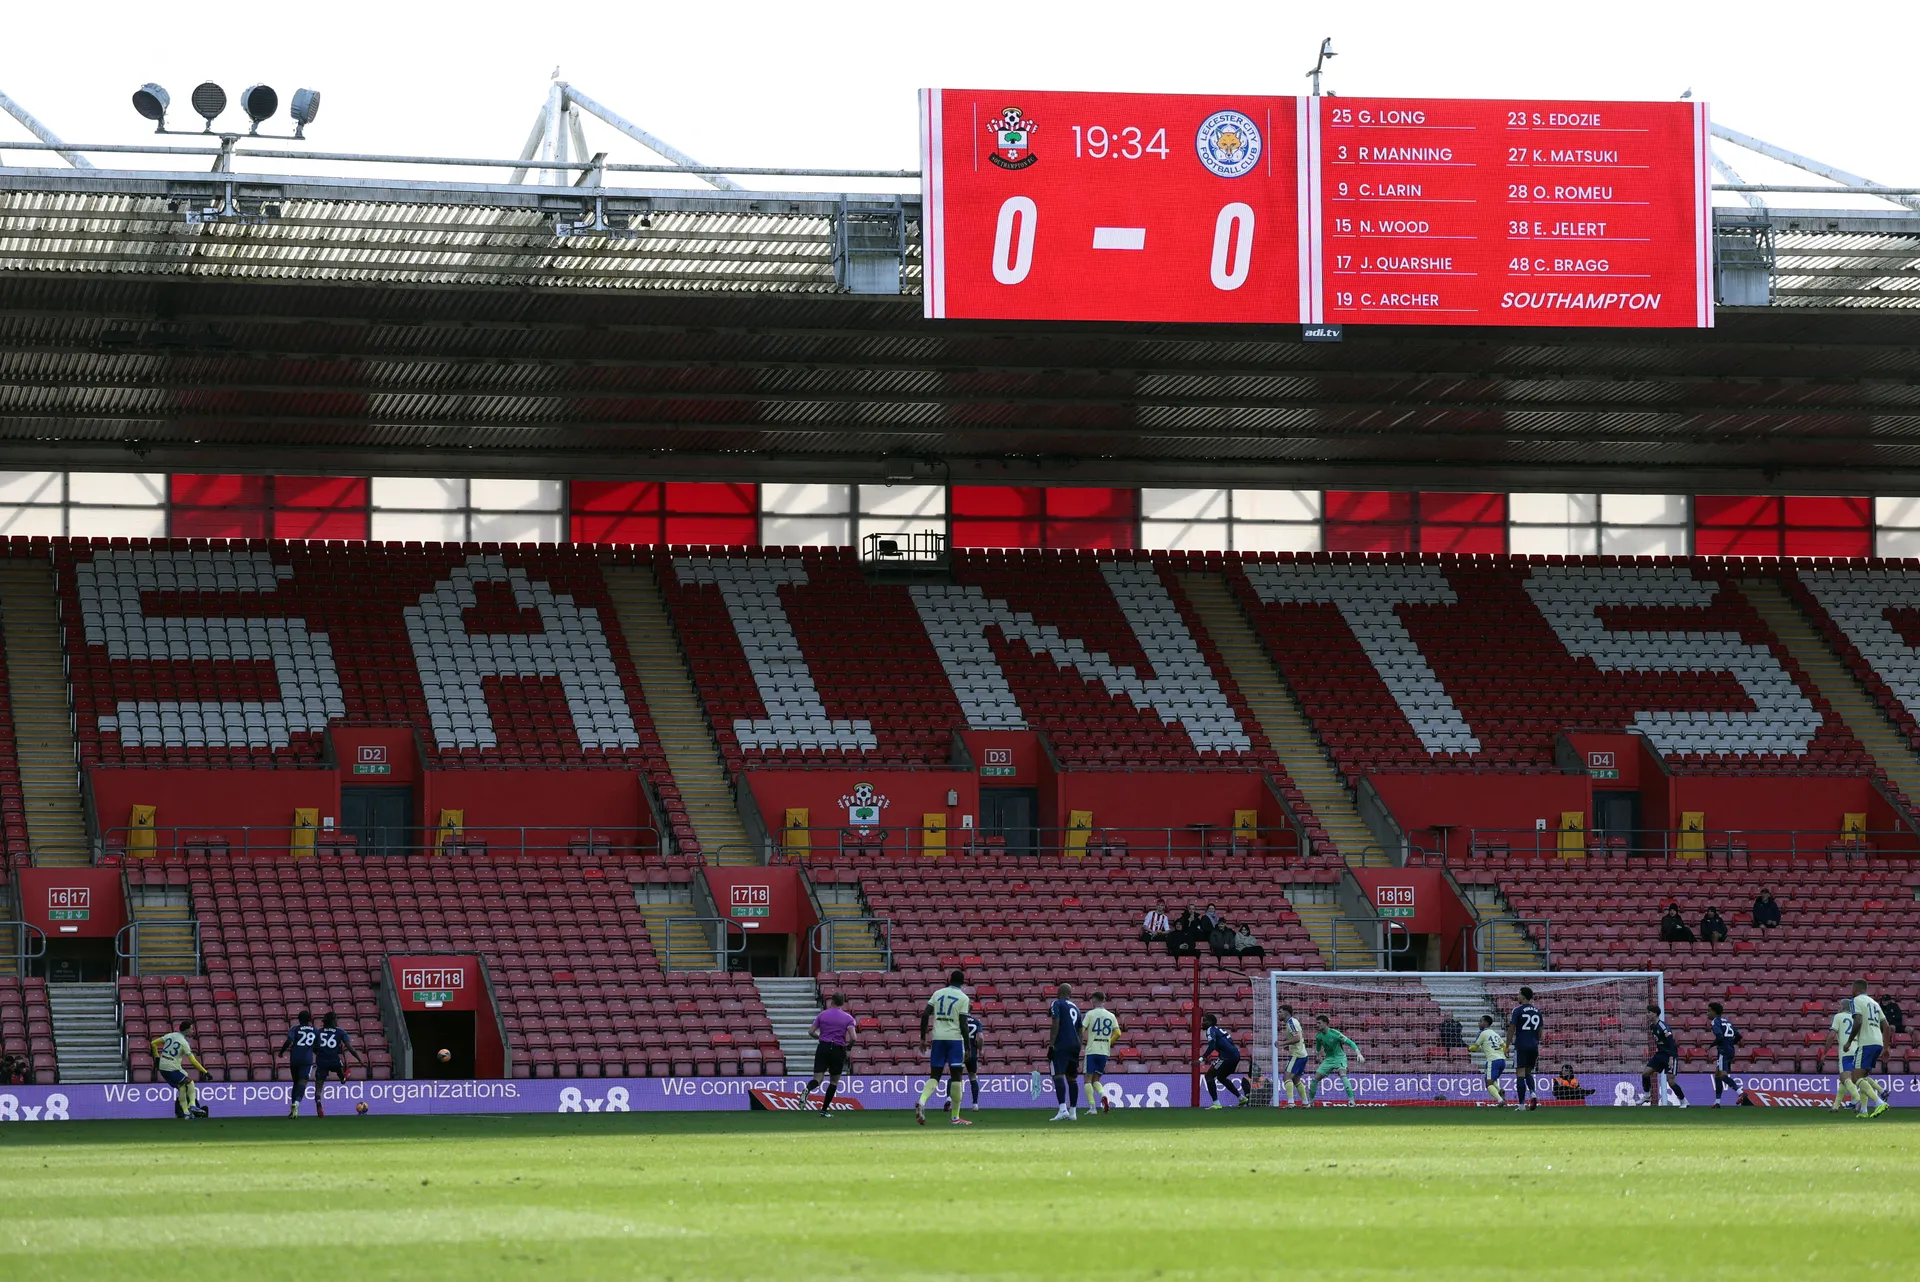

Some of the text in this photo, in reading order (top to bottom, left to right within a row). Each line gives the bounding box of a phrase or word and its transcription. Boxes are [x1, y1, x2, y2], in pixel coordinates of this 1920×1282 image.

[1332, 109, 1426, 125] 25 G. LONG
[1507, 112, 1601, 127] 23 S. EDOZIE
[1201, 115, 1257, 142] LEICESTER CITY
[1071, 125, 1170, 160] 19:34
[1201, 146, 1257, 174] FOOTBALL CLUB
[1337, 146, 1453, 161] 3 R MANNING
[1508, 148, 1618, 163] 27 K. MATSUKI
[1338, 183, 1422, 198] 9 C. LARIN
[1508, 185, 1613, 200] 28 O. ROMEU
[1336, 219, 1430, 234] 15 N. WOOD
[1508, 220, 1607, 236] 38 E. JELERT
[992, 195, 1038, 285] 0
[1210, 202, 1255, 291] 0
[1336, 255, 1453, 271] 17 J. QUARSHIE
[1508, 257, 1609, 272] 48 C. BRAGG
[1336, 292, 1439, 307] 19 C. ARCHER
[1500, 292, 1661, 310] SOUTHAMPTON
[1305, 328, 1340, 337] adi.tv
[363, 749, 381, 760] D2
[990, 751, 1007, 763] D3
[1593, 755, 1610, 766] D4
[51, 892, 87, 904] 16 17
[733, 890, 767, 900] 17 18
[1380, 890, 1412, 901] 18 19
[406, 973, 460, 985] 16 17 18
[937, 995, 959, 1016] 17
[1867, 1002, 1880, 1023] 15
[1069, 1007, 1078, 1026] 9
[1521, 1014, 1540, 1031] 29
[1092, 1017, 1113, 1036] 48
[1721, 1022, 1735, 1037] 25
[162, 1037, 181, 1057] 23
[297, 1031, 316, 1047] 28
[320, 1032, 337, 1049] 56
[662, 1078, 697, 1095] We
[701, 1078, 788, 1095] connect
[870, 1076, 908, 1093] and
[1395, 1073, 1427, 1092] and
[1748, 1074, 1830, 1092] connect
[104, 1085, 140, 1102] We
[243, 1085, 316, 1105] peope
[324, 1081, 364, 1099] and
[370, 1080, 521, 1103] organizations.
[558, 1086, 630, 1113] 8x8
[1102, 1082, 1170, 1107] 8x8
[0, 1093, 70, 1121] 8x8
